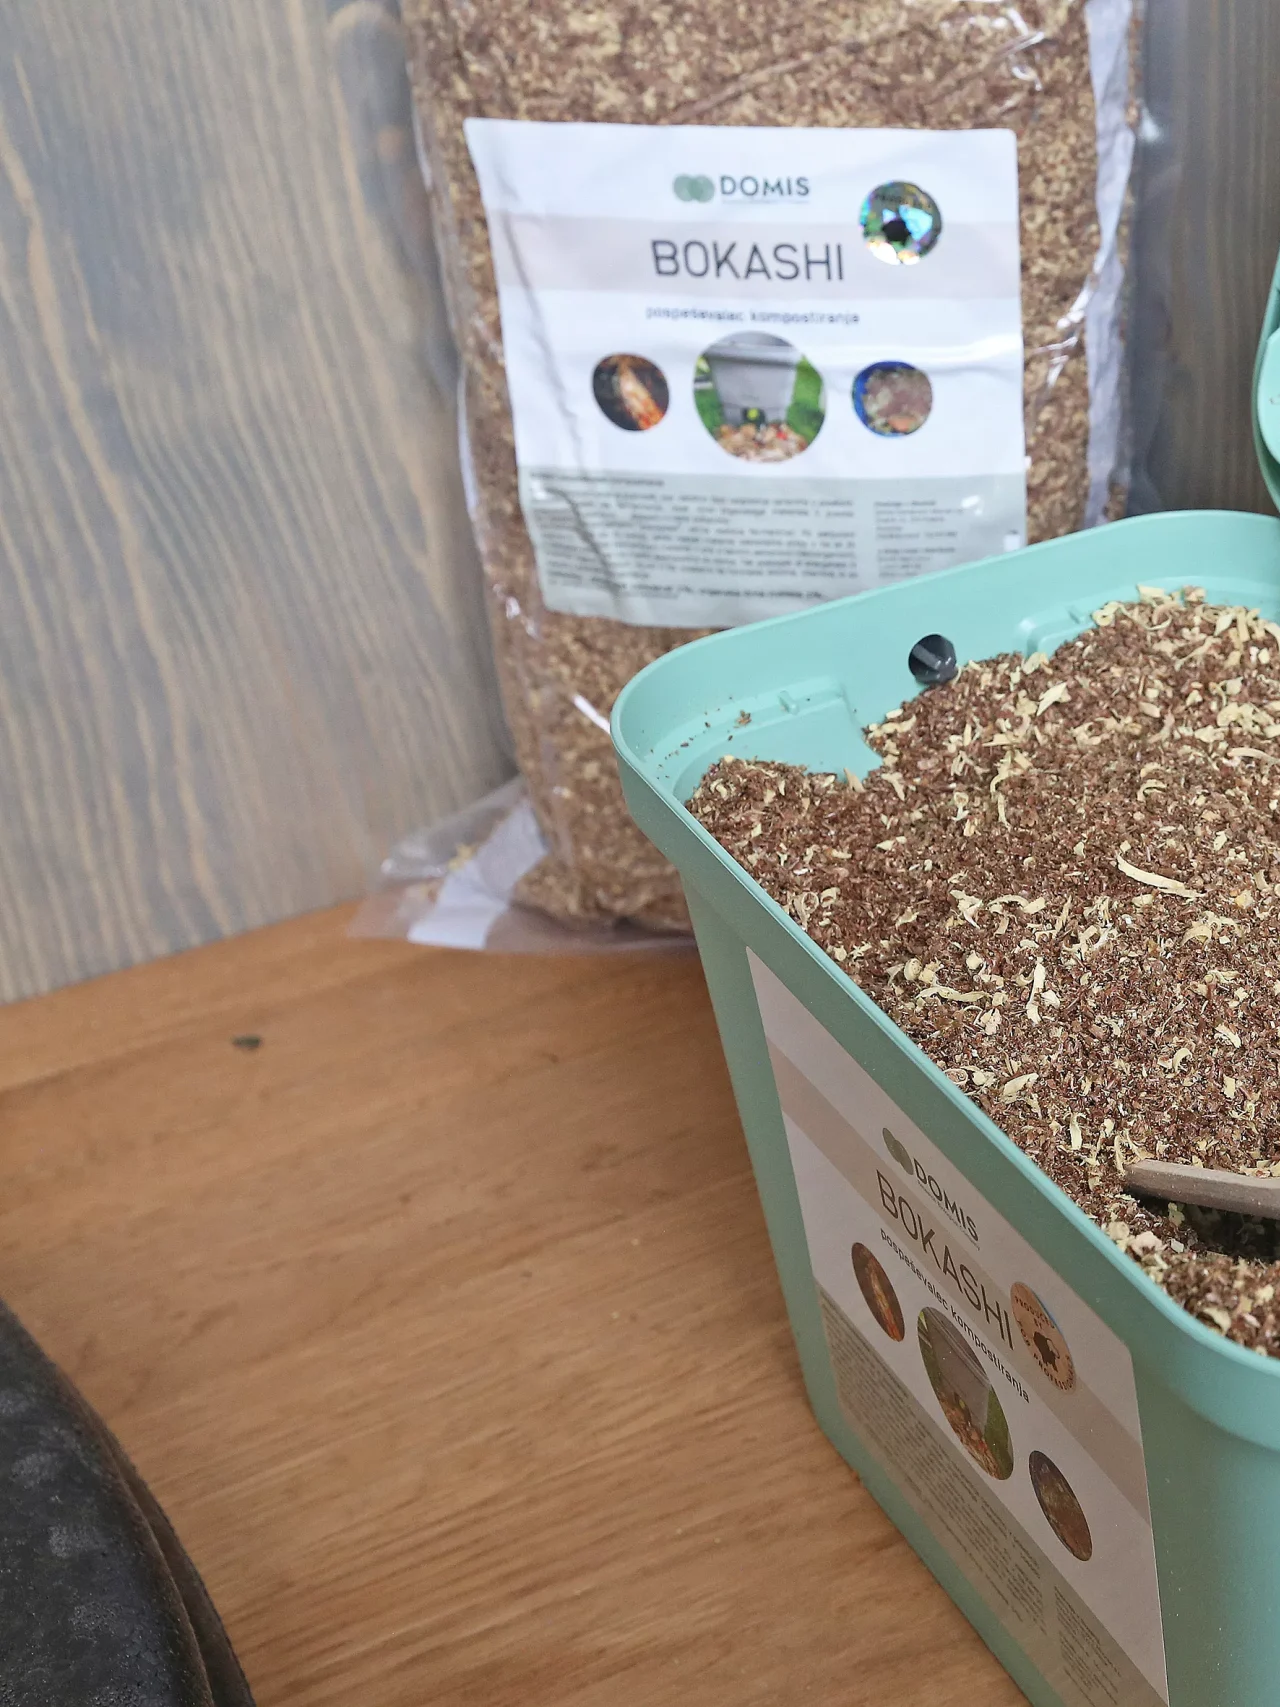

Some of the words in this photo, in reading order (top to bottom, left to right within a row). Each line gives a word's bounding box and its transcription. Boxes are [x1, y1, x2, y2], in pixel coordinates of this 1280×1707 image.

[719, 175, 811, 197] DOMIS
[651, 239, 845, 281] BOKASHI
[913, 1158, 979, 1241] DOMIS
[876, 1169, 1014, 1351] BOKASHI
